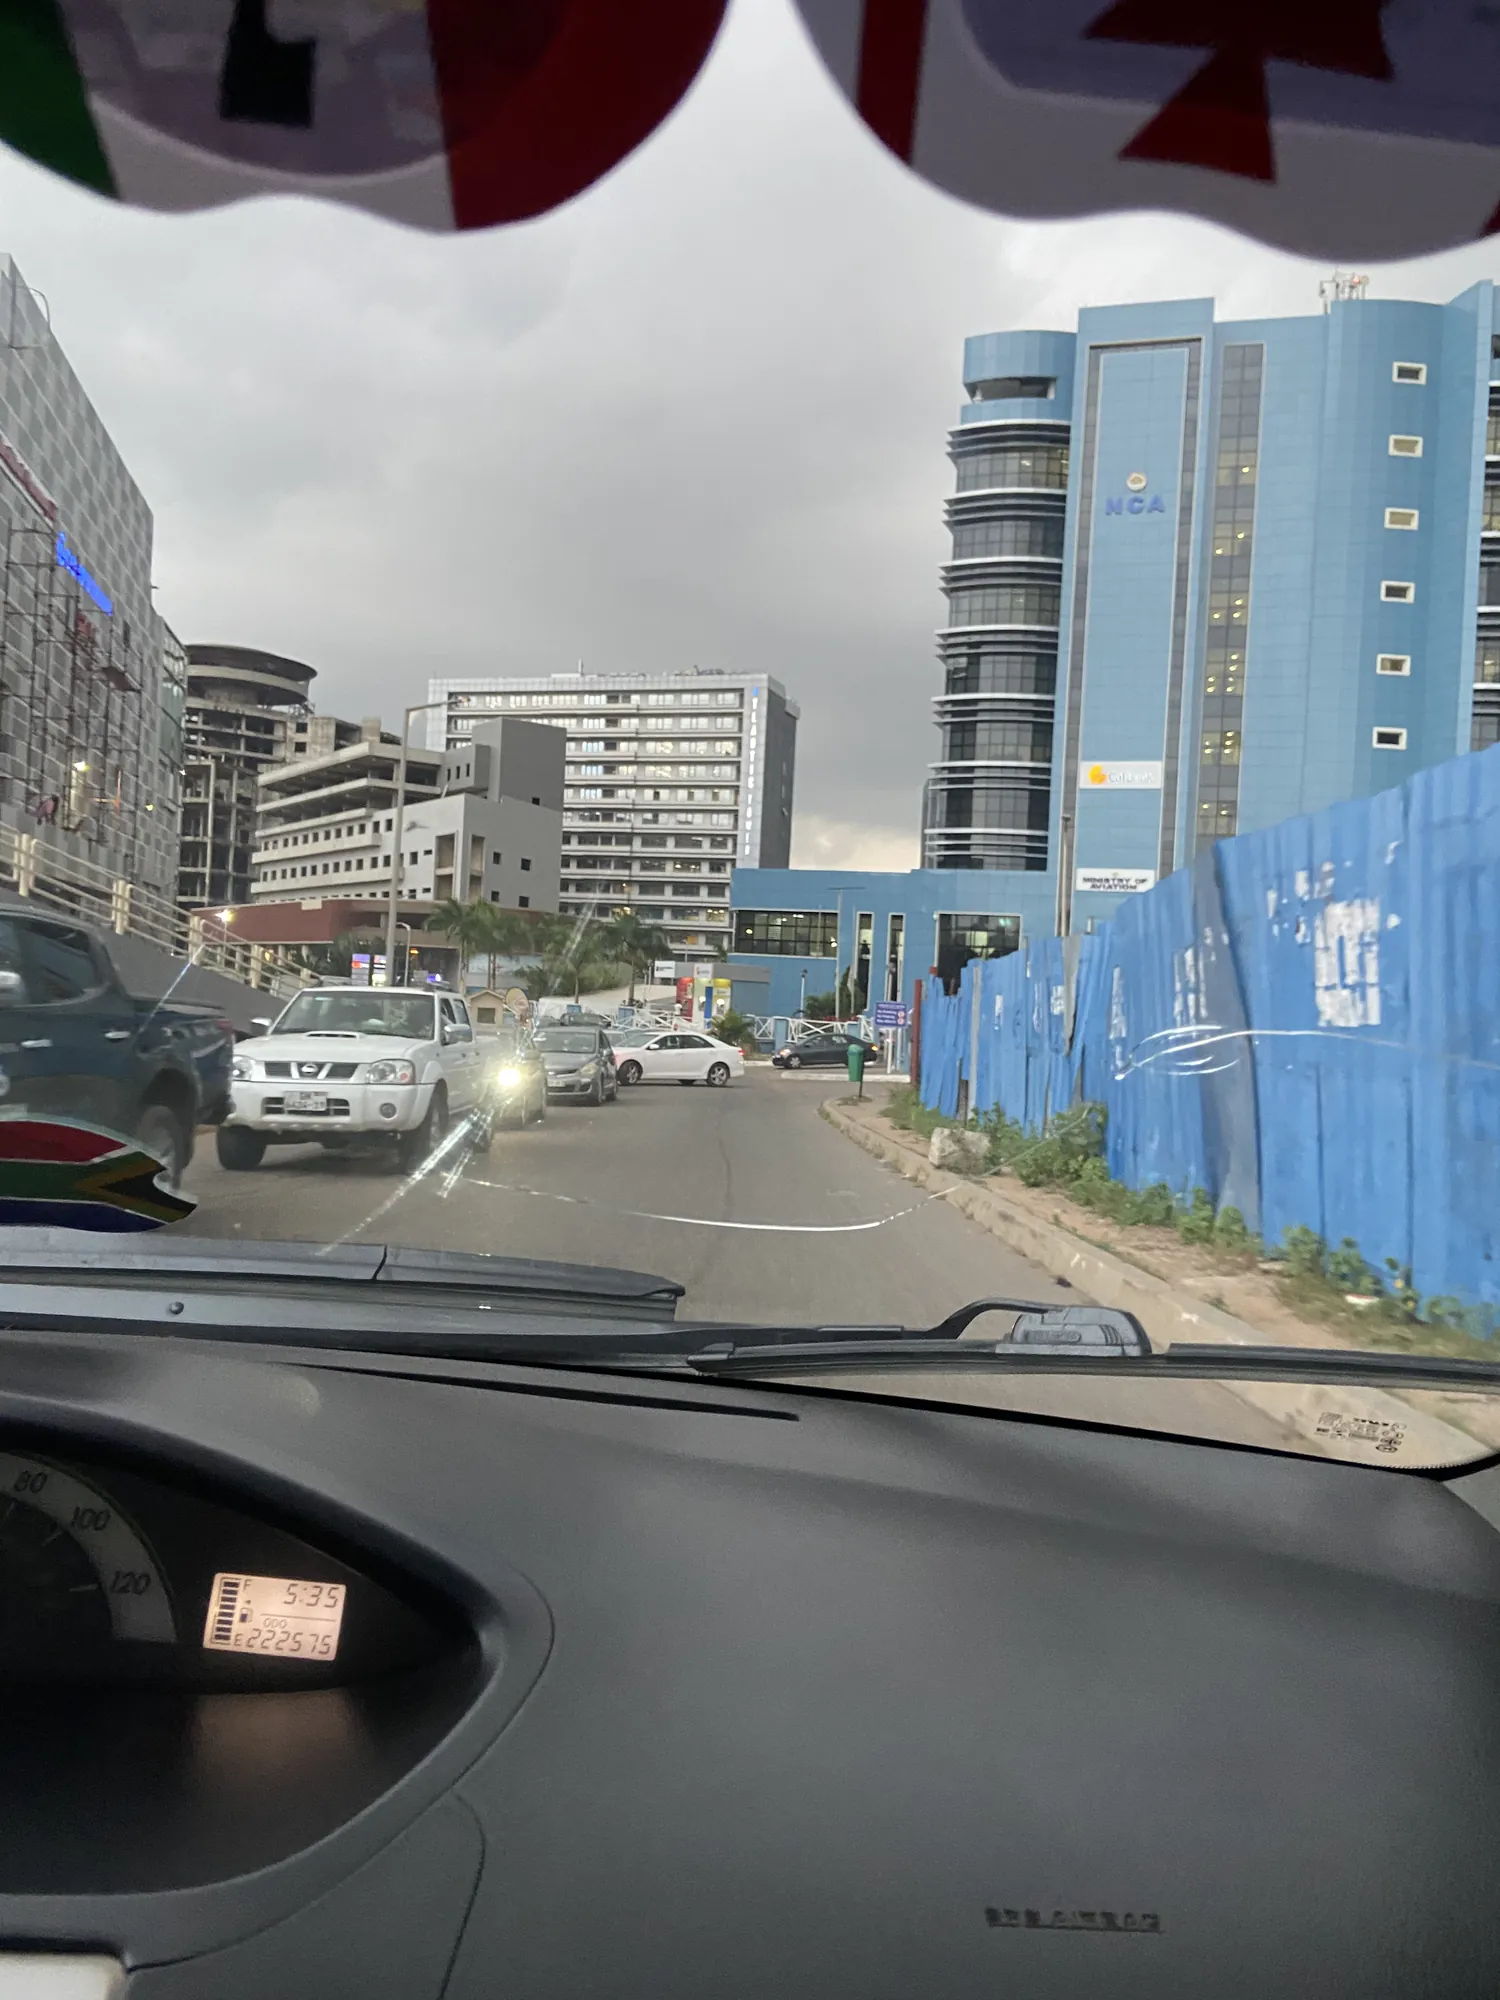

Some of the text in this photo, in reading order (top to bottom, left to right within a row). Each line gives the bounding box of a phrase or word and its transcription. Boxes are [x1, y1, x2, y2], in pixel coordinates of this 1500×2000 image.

[1105, 494, 1165, 516] NCA
[1083, 876, 1131, 884] MINISTRY
[14, 1470, 48, 1494] 80
[72, 1506, 111, 1531] 100
[111, 1570, 151, 1596] 120
[283, 1583, 340, 1608] 5:35
[246, 1628, 332, 1655] 222575
